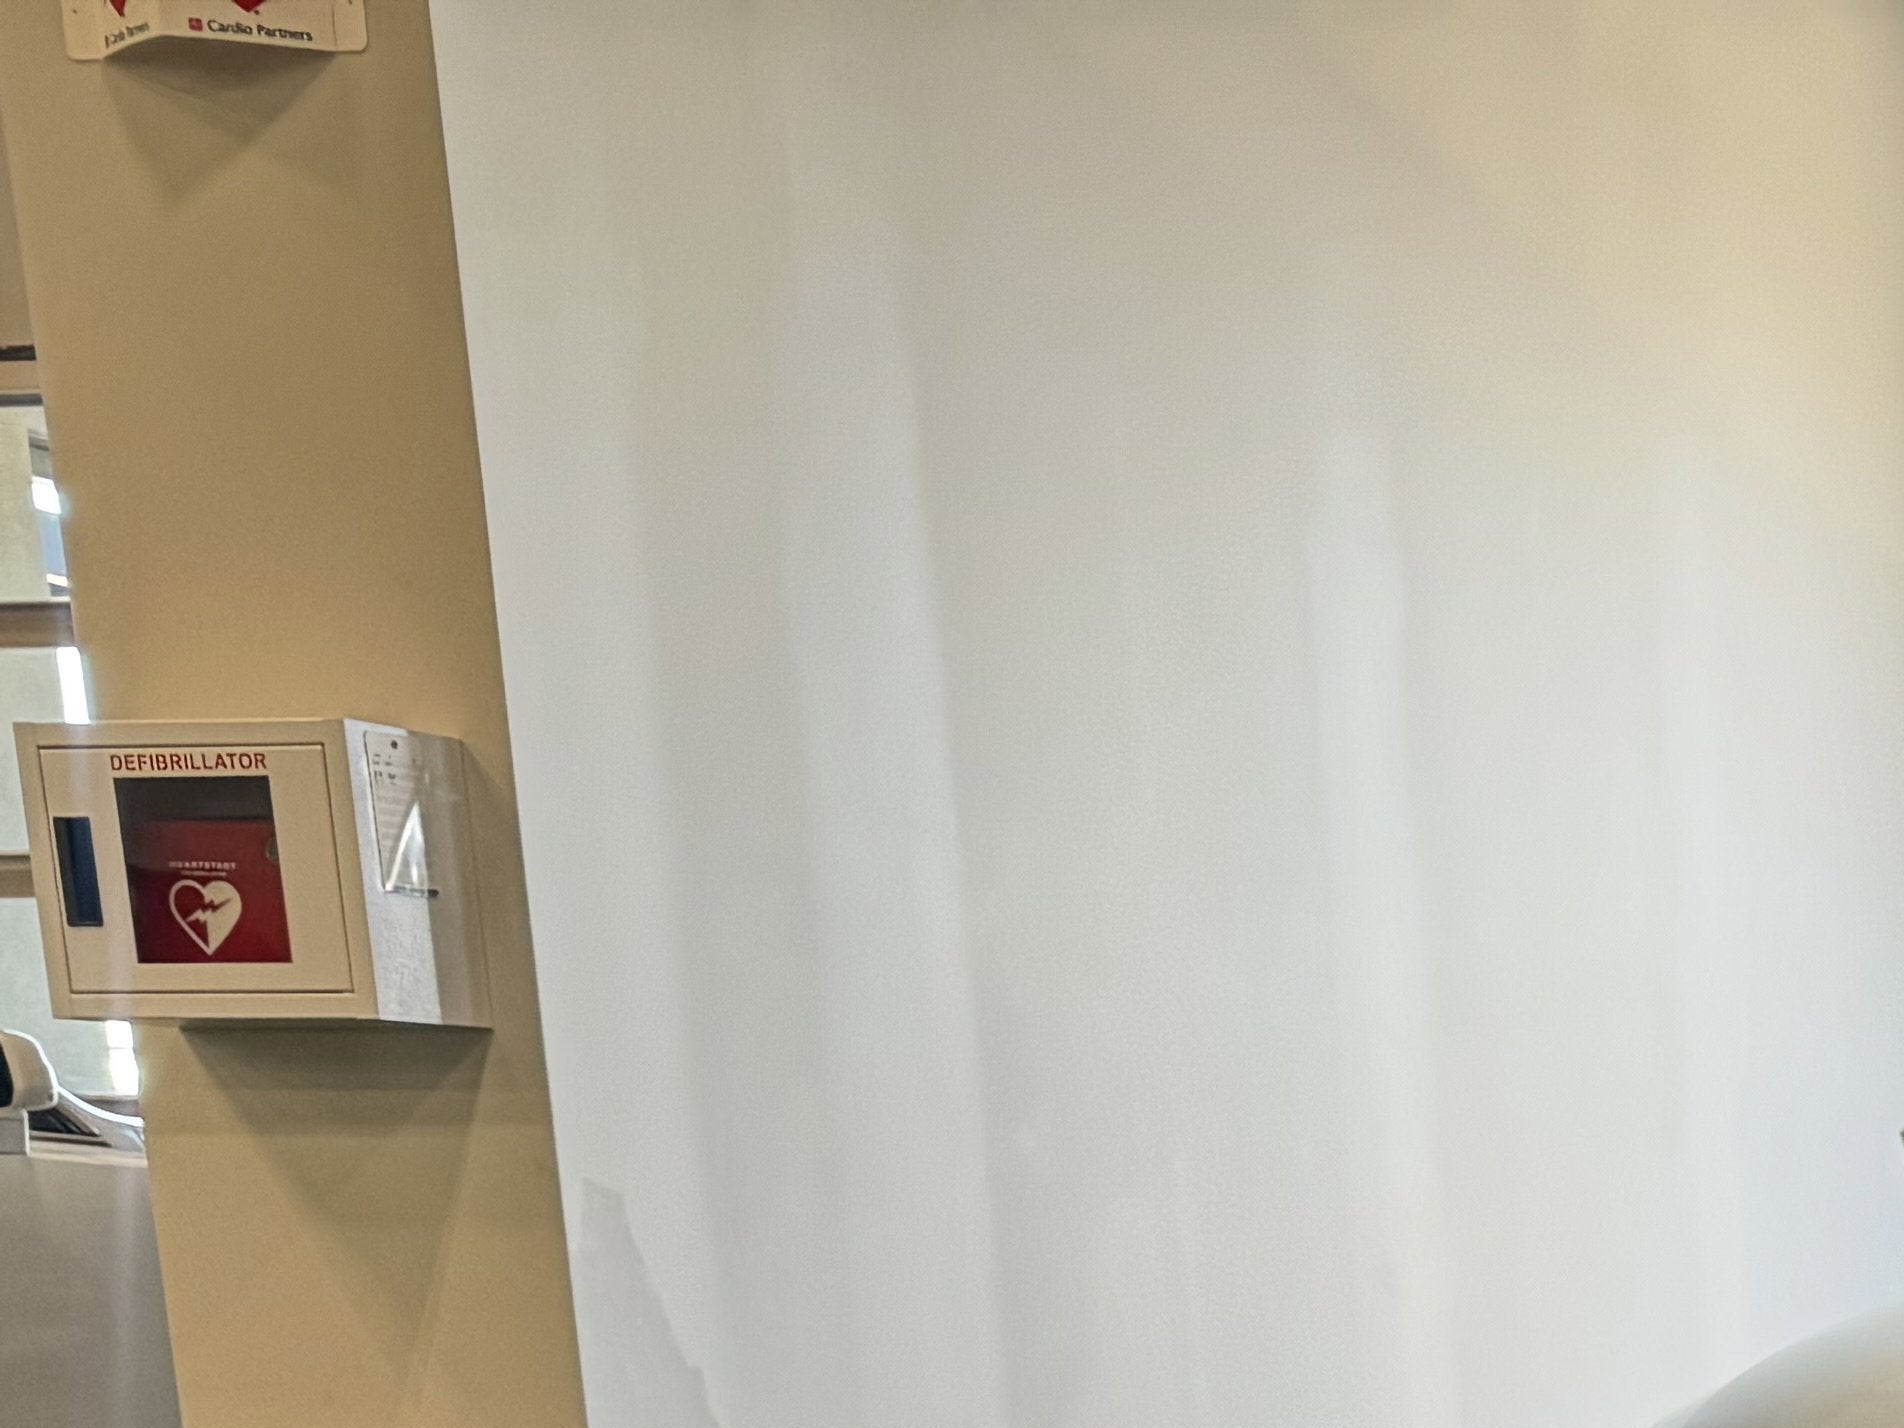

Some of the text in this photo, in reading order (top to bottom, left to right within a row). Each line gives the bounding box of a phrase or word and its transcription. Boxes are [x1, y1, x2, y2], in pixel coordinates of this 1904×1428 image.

[206, 19, 313, 42] Cardio Partners
[110, 752, 268, 772] DEFIBRILLATOR
